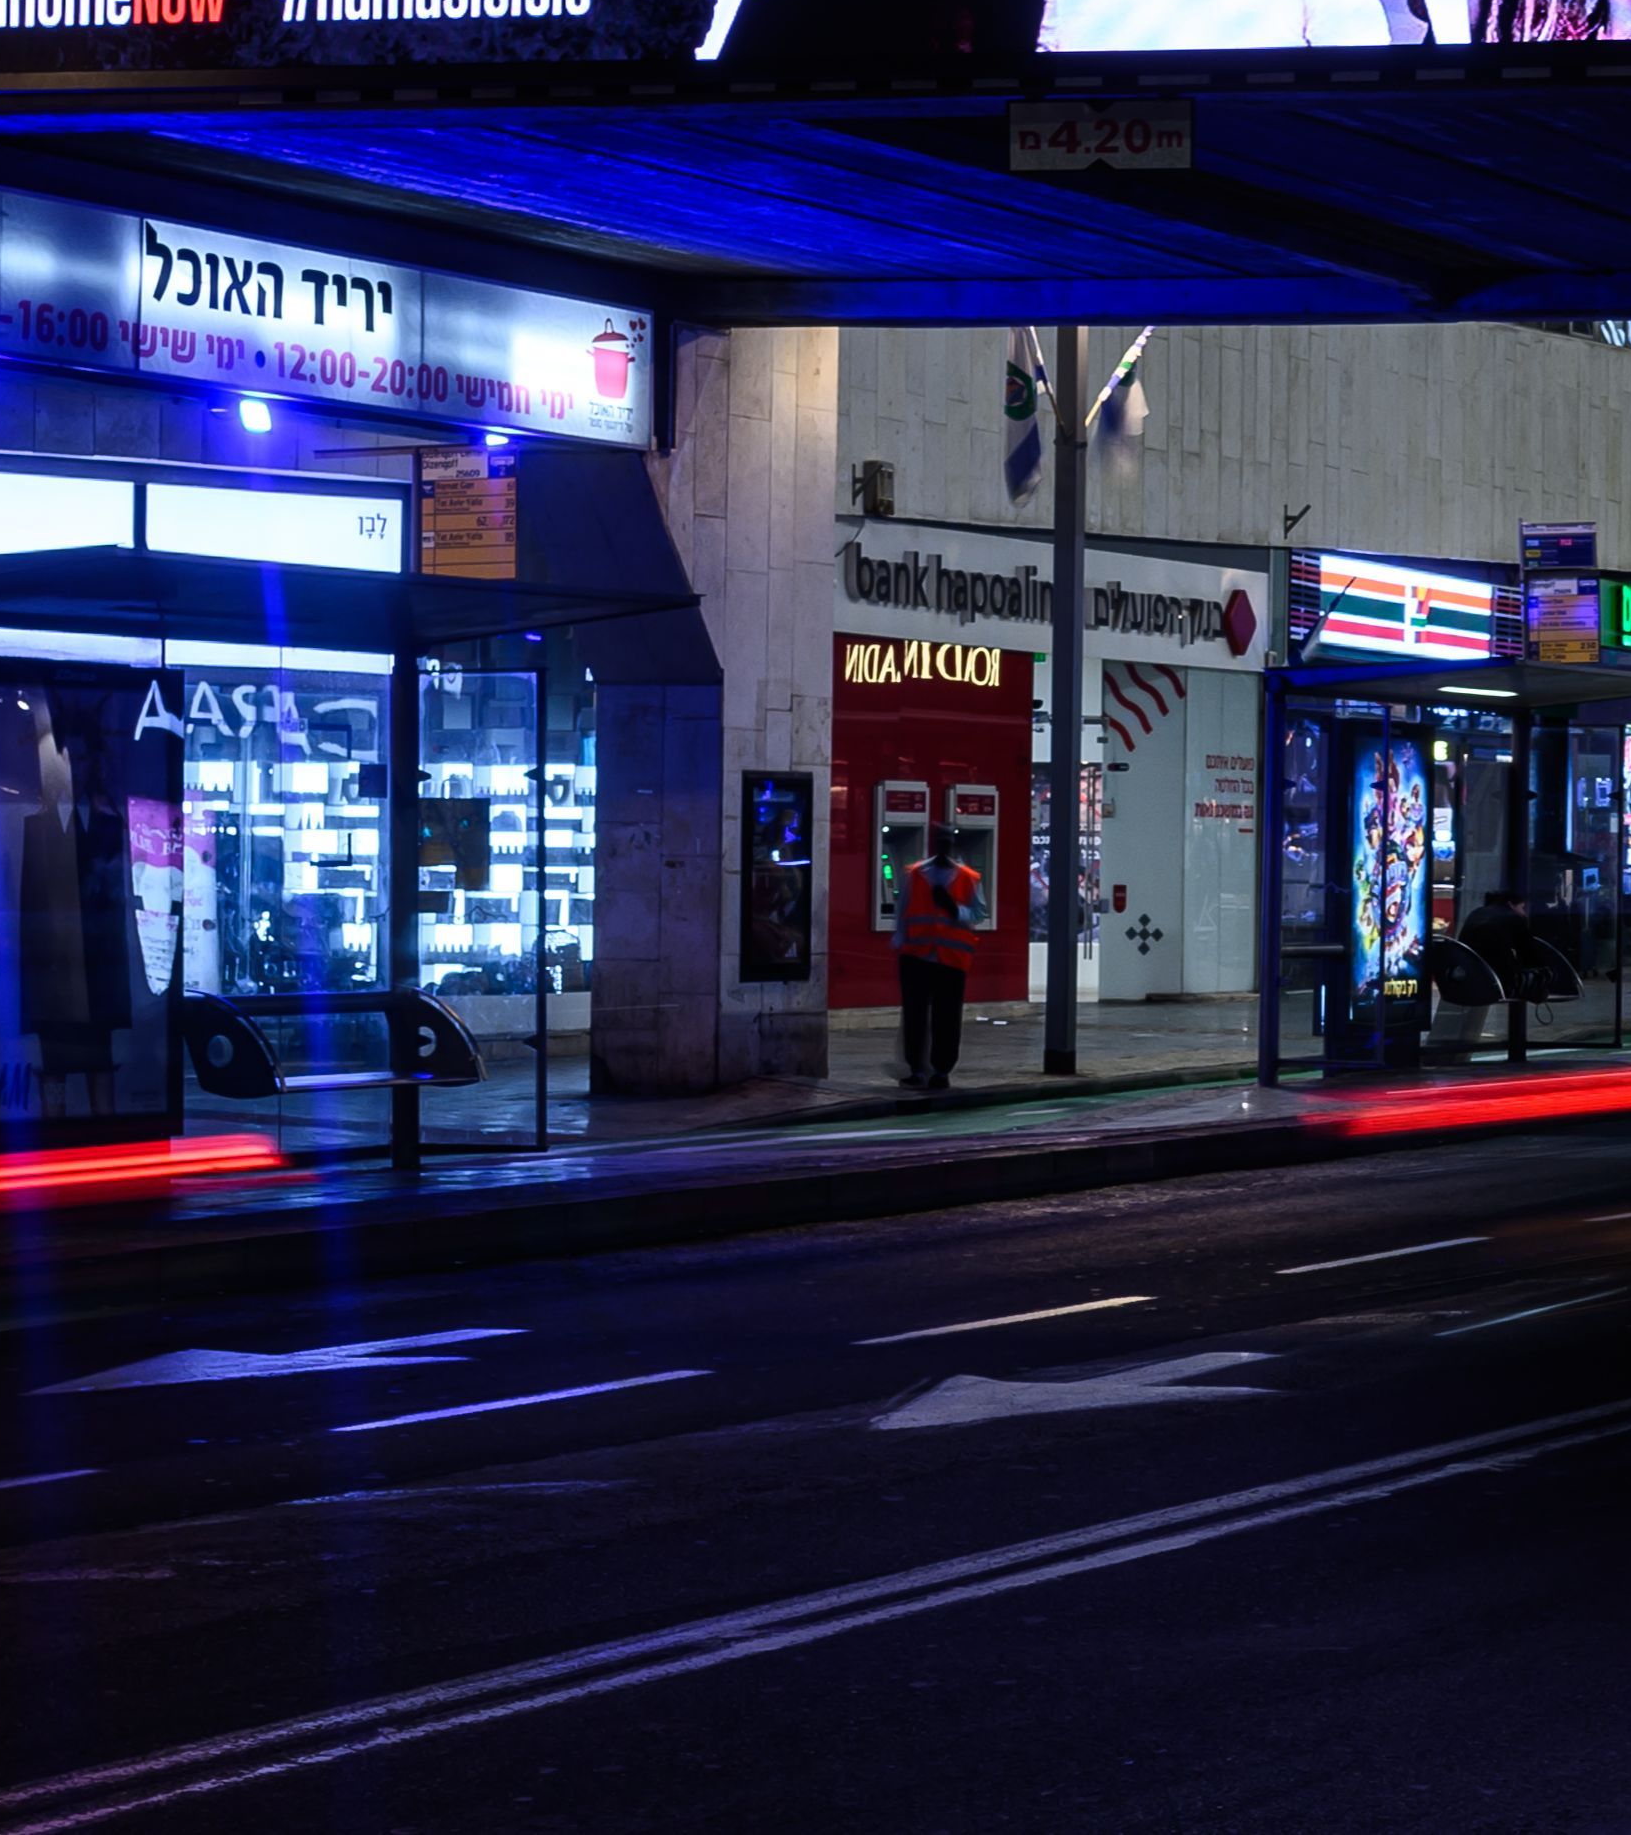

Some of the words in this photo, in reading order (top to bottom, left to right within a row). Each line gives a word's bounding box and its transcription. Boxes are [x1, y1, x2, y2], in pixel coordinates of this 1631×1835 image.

[145, 219, 284, 319] האוכל
[302, 268, 393, 332] יריד
[118, 319, 197, 364] שישי
[205, 333, 245, 371] ימי
[274, 341, 449, 403] 12:00-20:00
[456, 374, 532, 415] חמישי
[847, 542, 929, 609] bank
[1086, 581, 1183, 637] הפועלים
